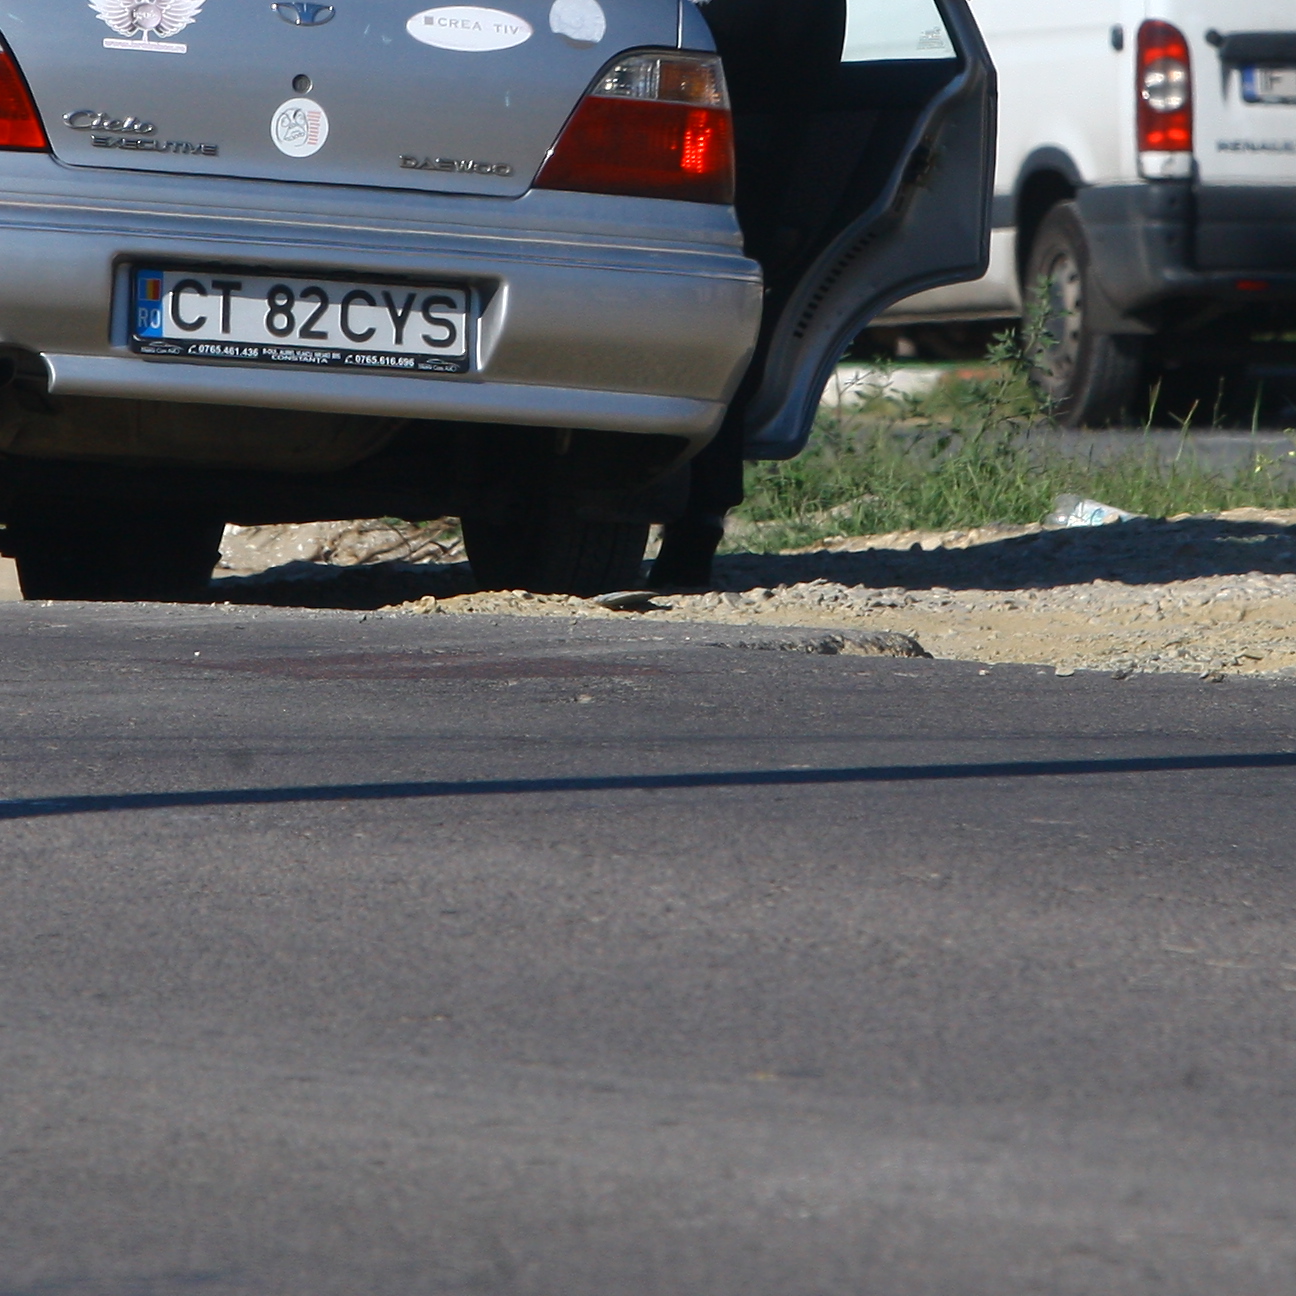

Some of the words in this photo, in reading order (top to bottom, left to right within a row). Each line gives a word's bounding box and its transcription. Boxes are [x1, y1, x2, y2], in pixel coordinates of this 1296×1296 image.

[437, 17, 482, 31] CREA
[62, 109, 154, 133] Cielo
[90, 134, 219, 155] EXECUTIVE
[399, 155, 514, 177] DAEWOO
[170, 278, 242, 334] CT
[137, 307, 162, 329] RO
